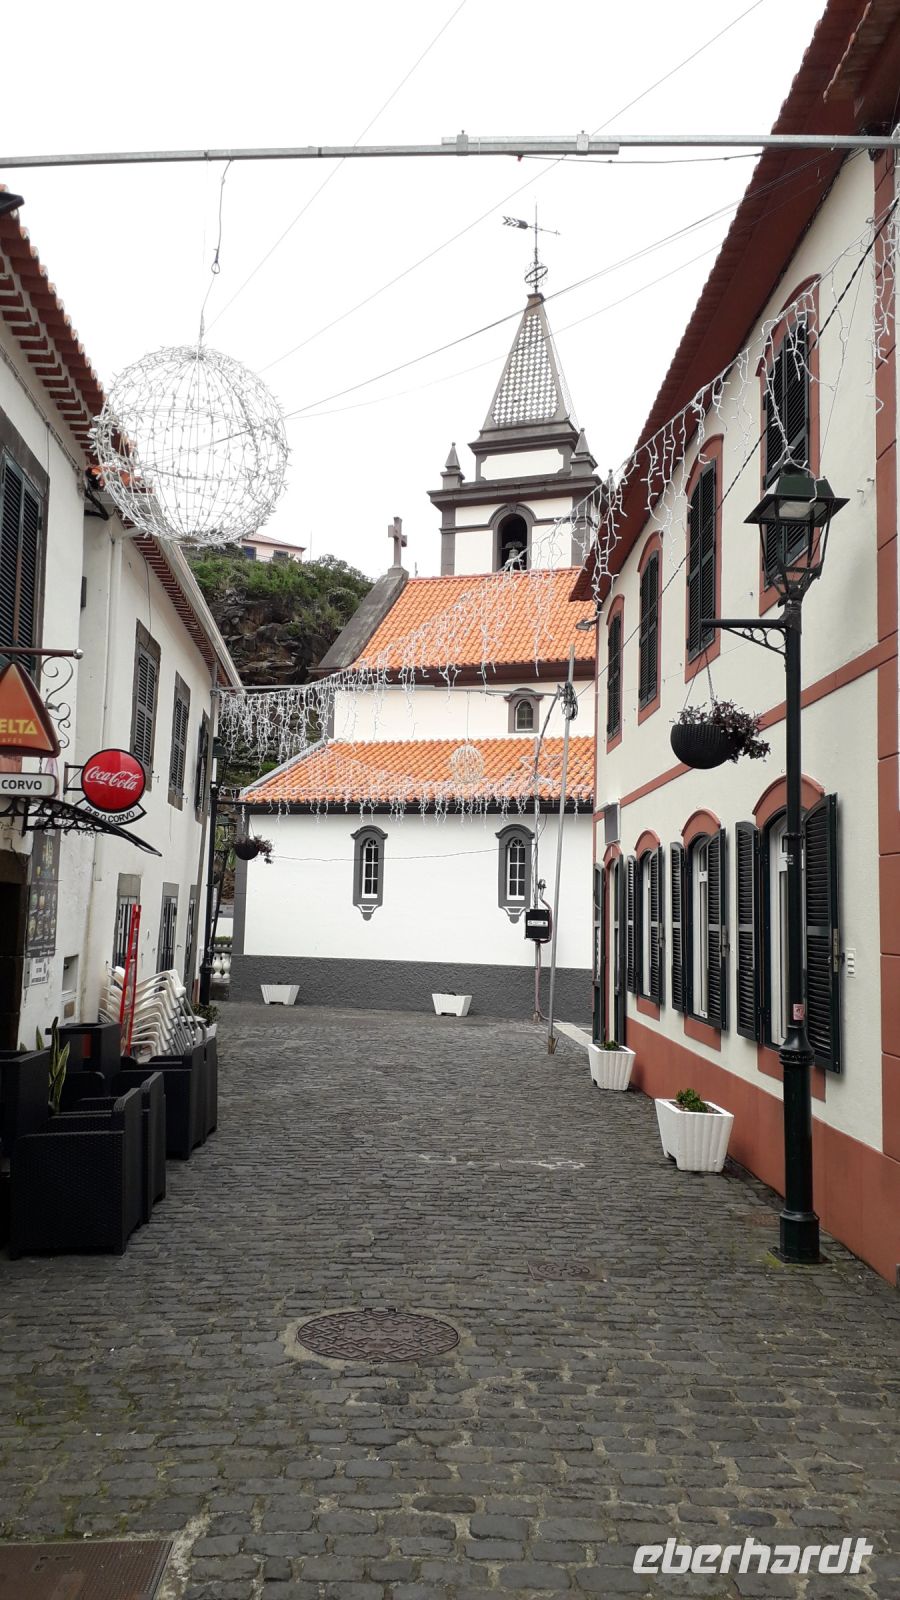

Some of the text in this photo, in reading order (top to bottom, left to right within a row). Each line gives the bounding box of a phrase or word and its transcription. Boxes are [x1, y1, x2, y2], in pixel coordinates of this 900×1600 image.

[1, 779, 42, 790] CORVO
[84, 766, 141, 791] Coca-Cola
[107, 810, 135, 823] CORVO
